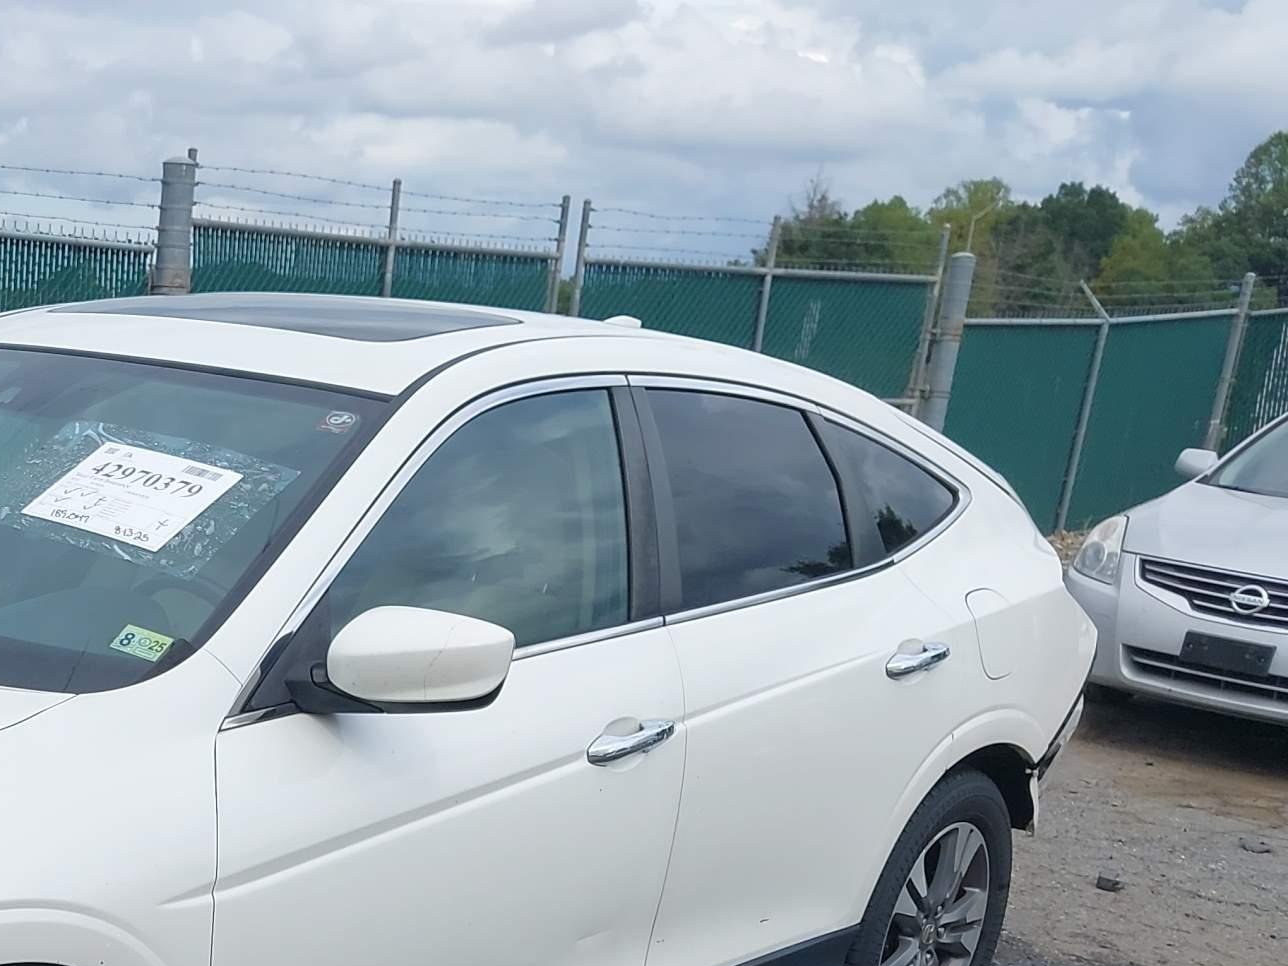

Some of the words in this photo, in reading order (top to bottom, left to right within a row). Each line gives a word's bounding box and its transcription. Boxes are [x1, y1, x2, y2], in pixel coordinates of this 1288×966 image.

[92, 461, 204, 498] 42970379
[119, 632, 136, 647] 8
[148, 640, 167, 653] 25
